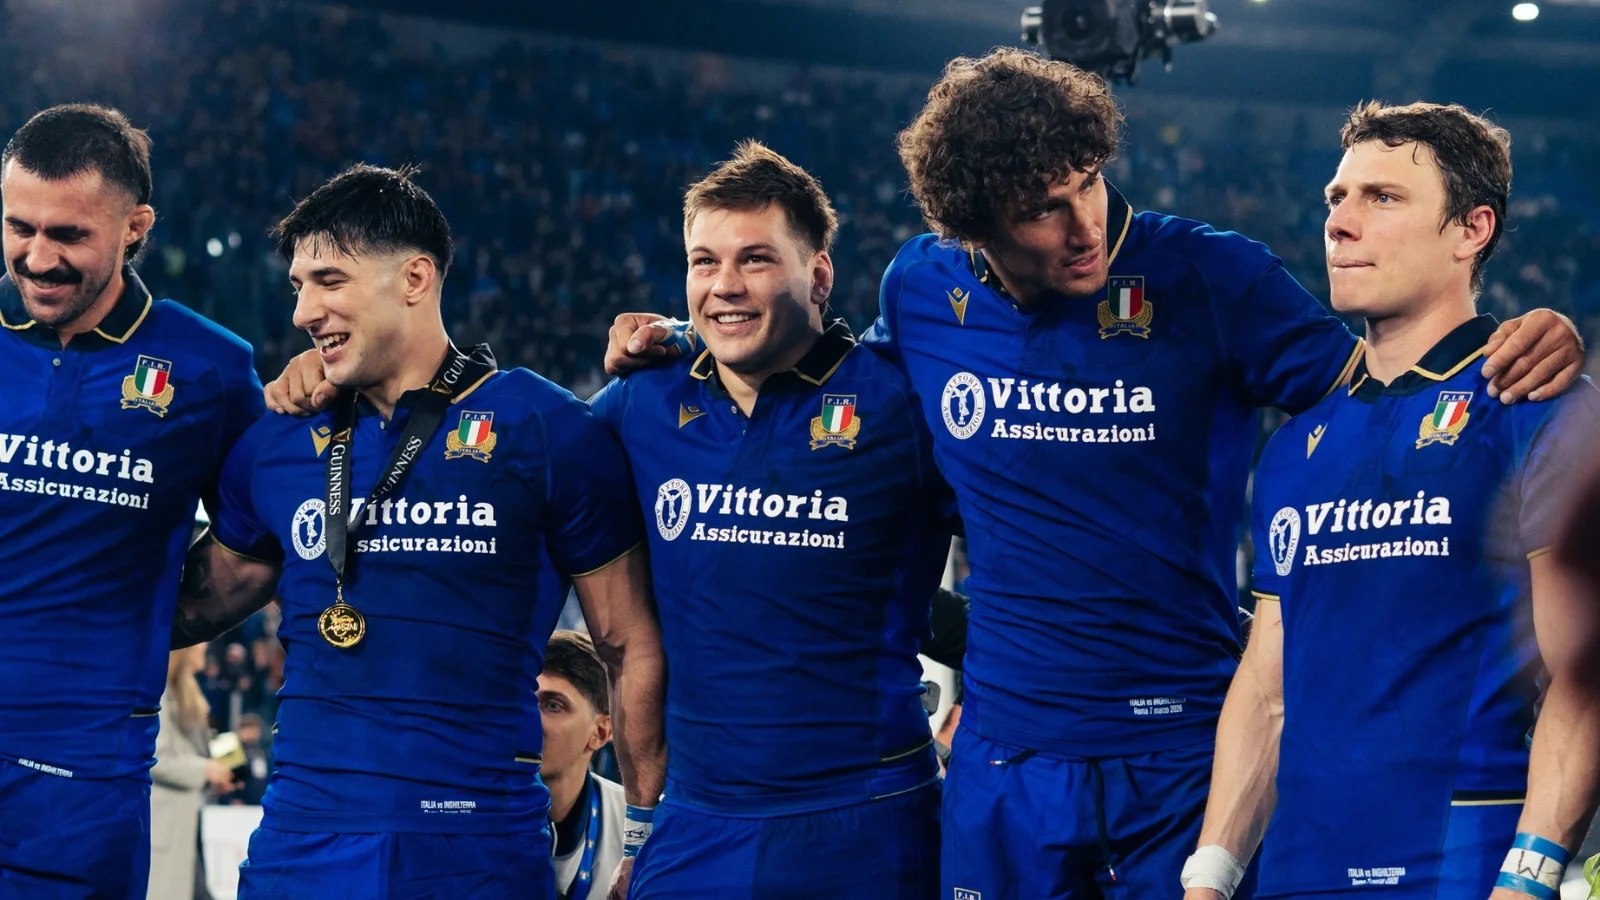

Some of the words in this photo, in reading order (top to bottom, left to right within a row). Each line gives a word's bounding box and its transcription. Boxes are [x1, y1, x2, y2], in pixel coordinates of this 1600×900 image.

[142, 359, 166, 371] F.I.R.
[945, 375, 981, 394] VITTORIA
[987, 378, 1155, 413] Vittoria
[135, 397, 157, 406] ITALIA
[827, 397, 852, 405] F.I.R.
[465, 413, 489, 421] F.I.R.
[943, 406, 982, 437] ASSICURAZIONI
[991, 418, 1155, 442] Assicurazioni
[0, 433, 154, 483] Vittoria
[0, 472, 149, 509] Assicurazioni
[329, 444, 345, 515] GUINNESS
[697, 484, 848, 521] Vittoria
[1305, 491, 1451, 534] Vittoria
[355, 535, 496, 553] ssicurazioni
[691, 523, 844, 548] Assicurazioni
[1304, 537, 1449, 565] Assicurazioni
[1134, 707, 1149, 715] Roma
[1154, 706, 1169, 714] marzo
[1170, 704, 1182, 713] 2026
[18, 758, 35, 768] ITALIA
[41, 764, 73, 778] INGHILTERRA
[421, 800, 436, 809] ITALIA
[444, 800, 476, 809] INGHILTERRA
[1348, 868, 1364, 877] ITALIA
[1365, 869, 1371, 877] vs
[1371, 867, 1406, 877] INGHILTERRA
